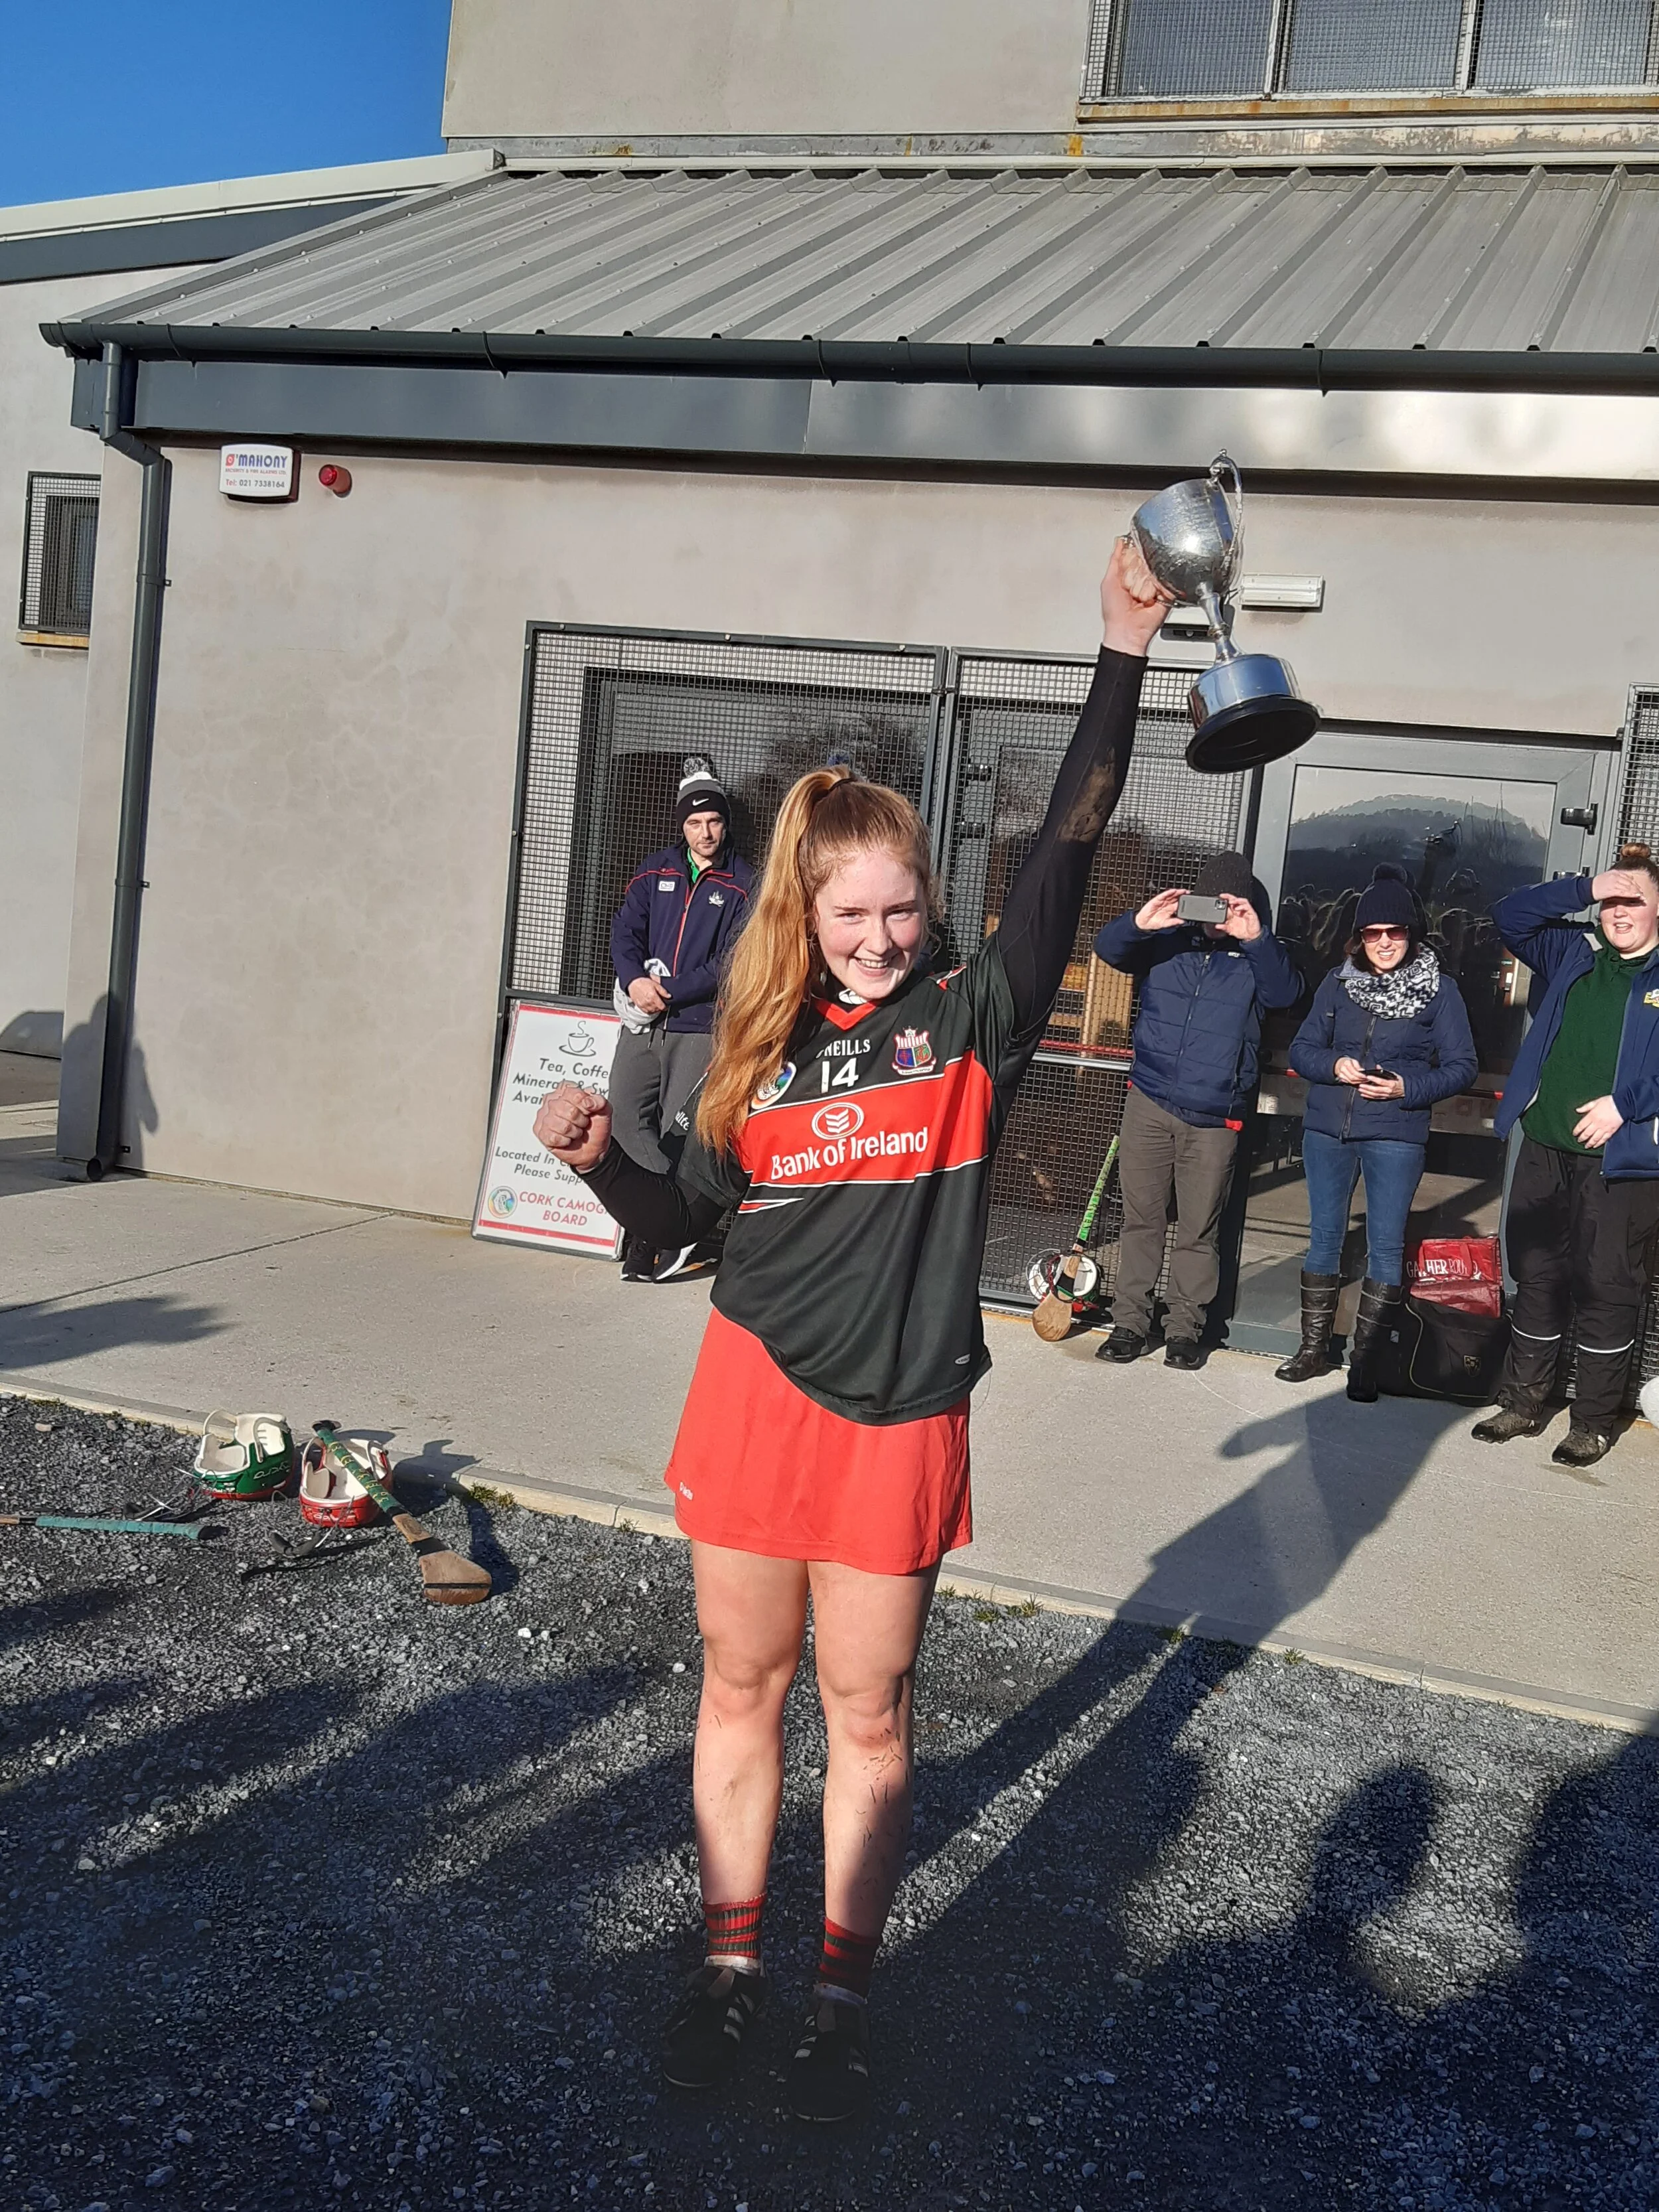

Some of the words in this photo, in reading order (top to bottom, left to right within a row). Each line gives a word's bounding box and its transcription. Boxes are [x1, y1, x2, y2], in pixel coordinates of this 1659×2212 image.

[226, 454, 288, 468] O'MAHONY
[816, 1039, 871, 1059] NEILLS
[540, 1058, 566, 1075] Tea,
[573, 1063, 609, 1078] Coffe
[822, 1058, 859, 1094] 14
[512, 1090, 544, 1104] Avai
[495, 1146, 541, 1162] Located
[543, 1153, 555, 1165] In
[771, 1147, 822, 1180] Bank
[823, 1138, 847, 1166] of
[850, 1127, 928, 1160] Ireland
[514, 1163, 551, 1179] Please
[554, 1169, 583, 1186] Supp
[520, 1191, 554, 1206] CORK
[557, 1197, 607, 1214] CAMOG
[543, 1211, 587, 1226] BOARD
[1407, 1259, 1449, 1278] GAHER
